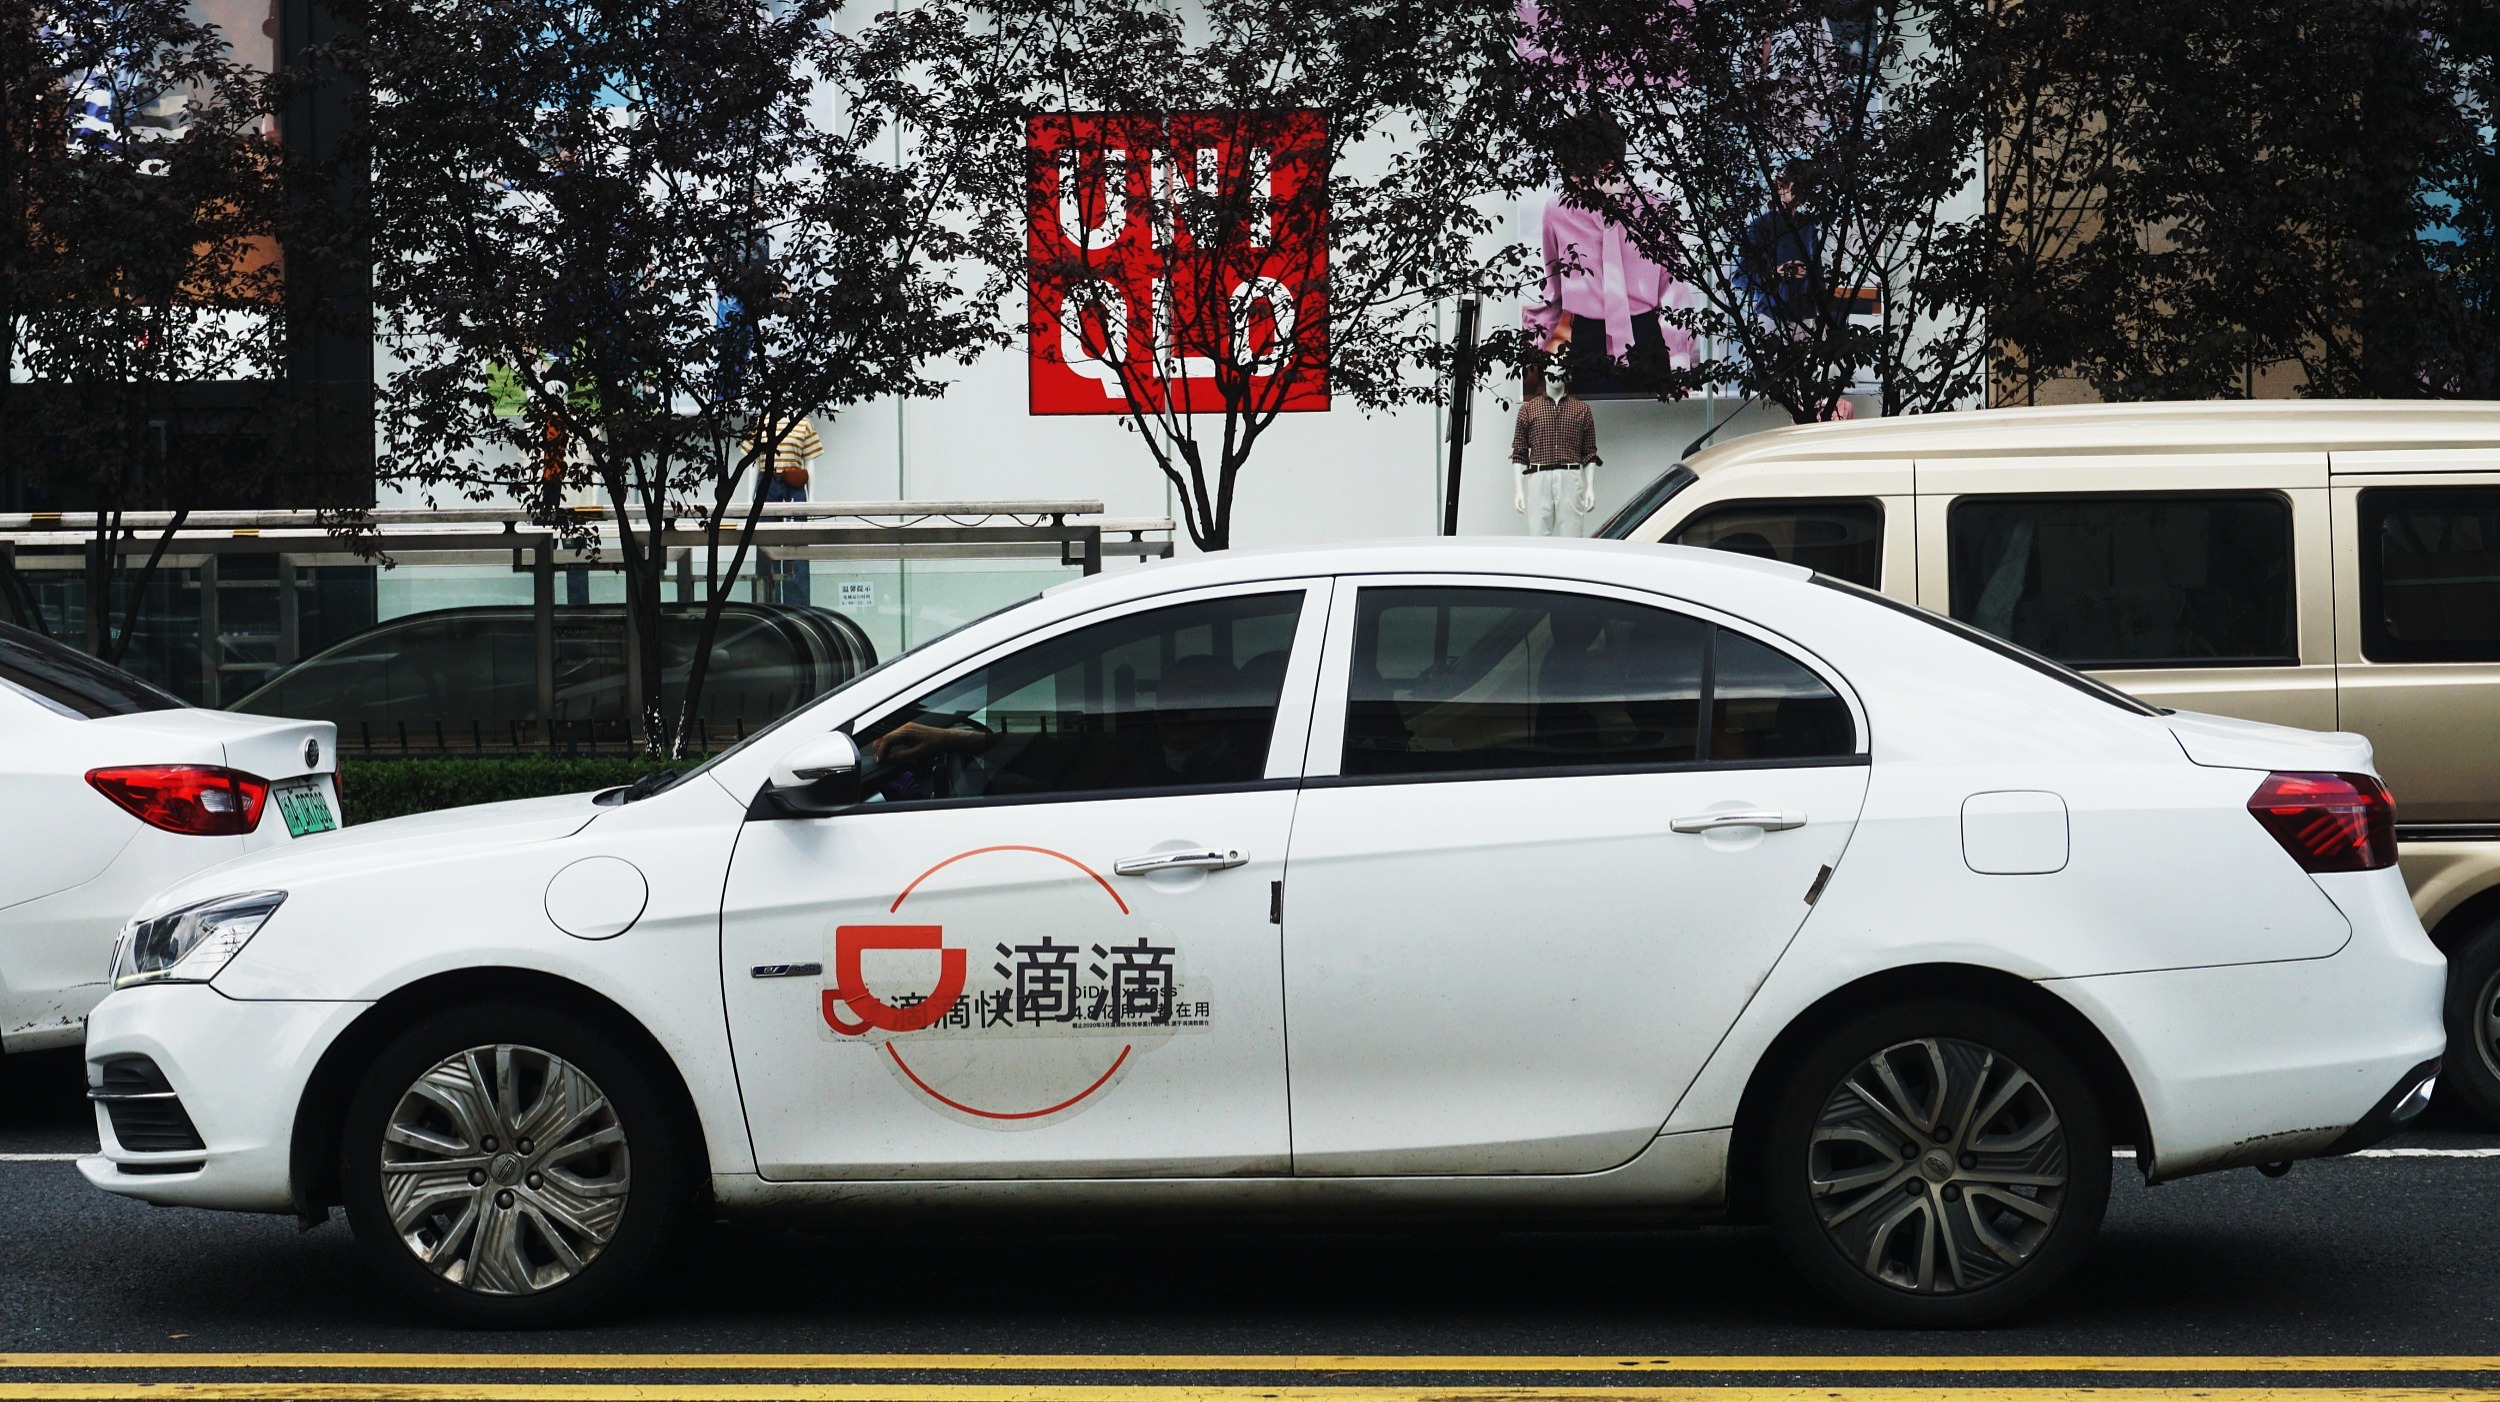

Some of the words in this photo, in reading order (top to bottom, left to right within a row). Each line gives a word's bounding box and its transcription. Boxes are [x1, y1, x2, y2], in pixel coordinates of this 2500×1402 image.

[1058, 147, 1272, 251] UNI
[1060, 276, 1296, 399] QLO
[993, 936, 1176, 1023] 滴滴
[1074, 985, 1106, 999] DiD
